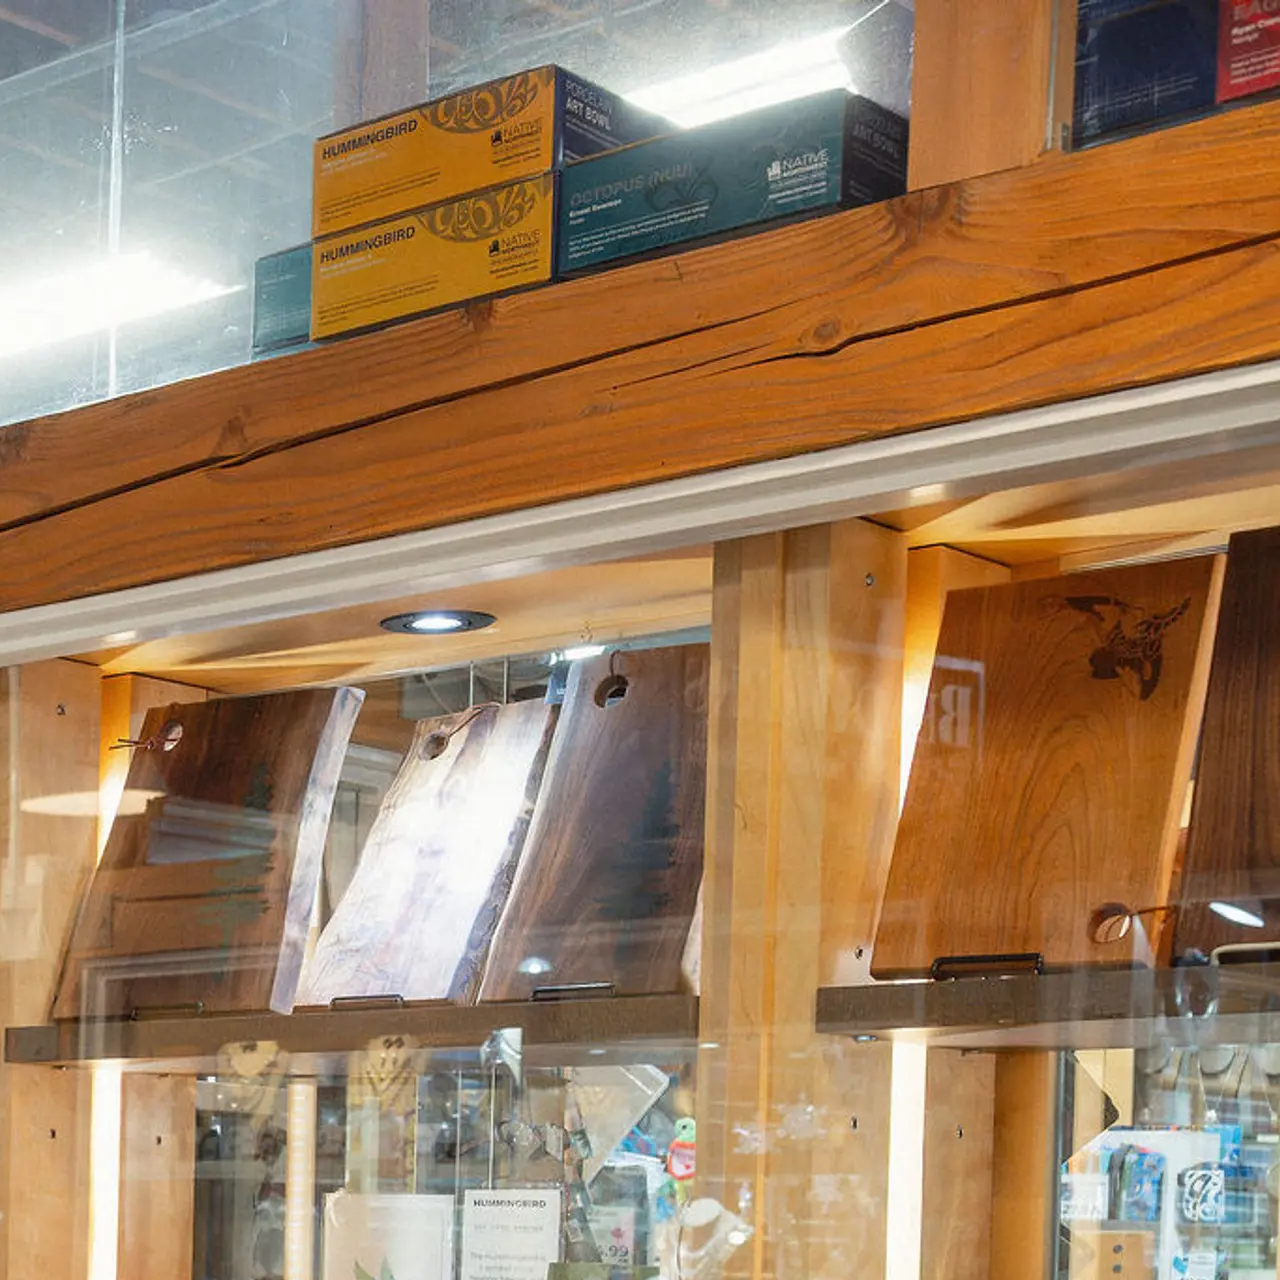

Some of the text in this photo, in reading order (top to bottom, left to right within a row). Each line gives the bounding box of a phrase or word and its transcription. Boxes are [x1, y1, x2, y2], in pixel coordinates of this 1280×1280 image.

[322, 119, 418, 161] HUMMINGBIRD
[783, 147, 829, 172] NATIVE
[570, 174, 644, 206] OCTOPUS
[320, 226, 416, 264] HUMMINGBIRD
[501, 229, 541, 251] NATIVE
[473, 1198, 547, 1209] HUMMINGBIRD
